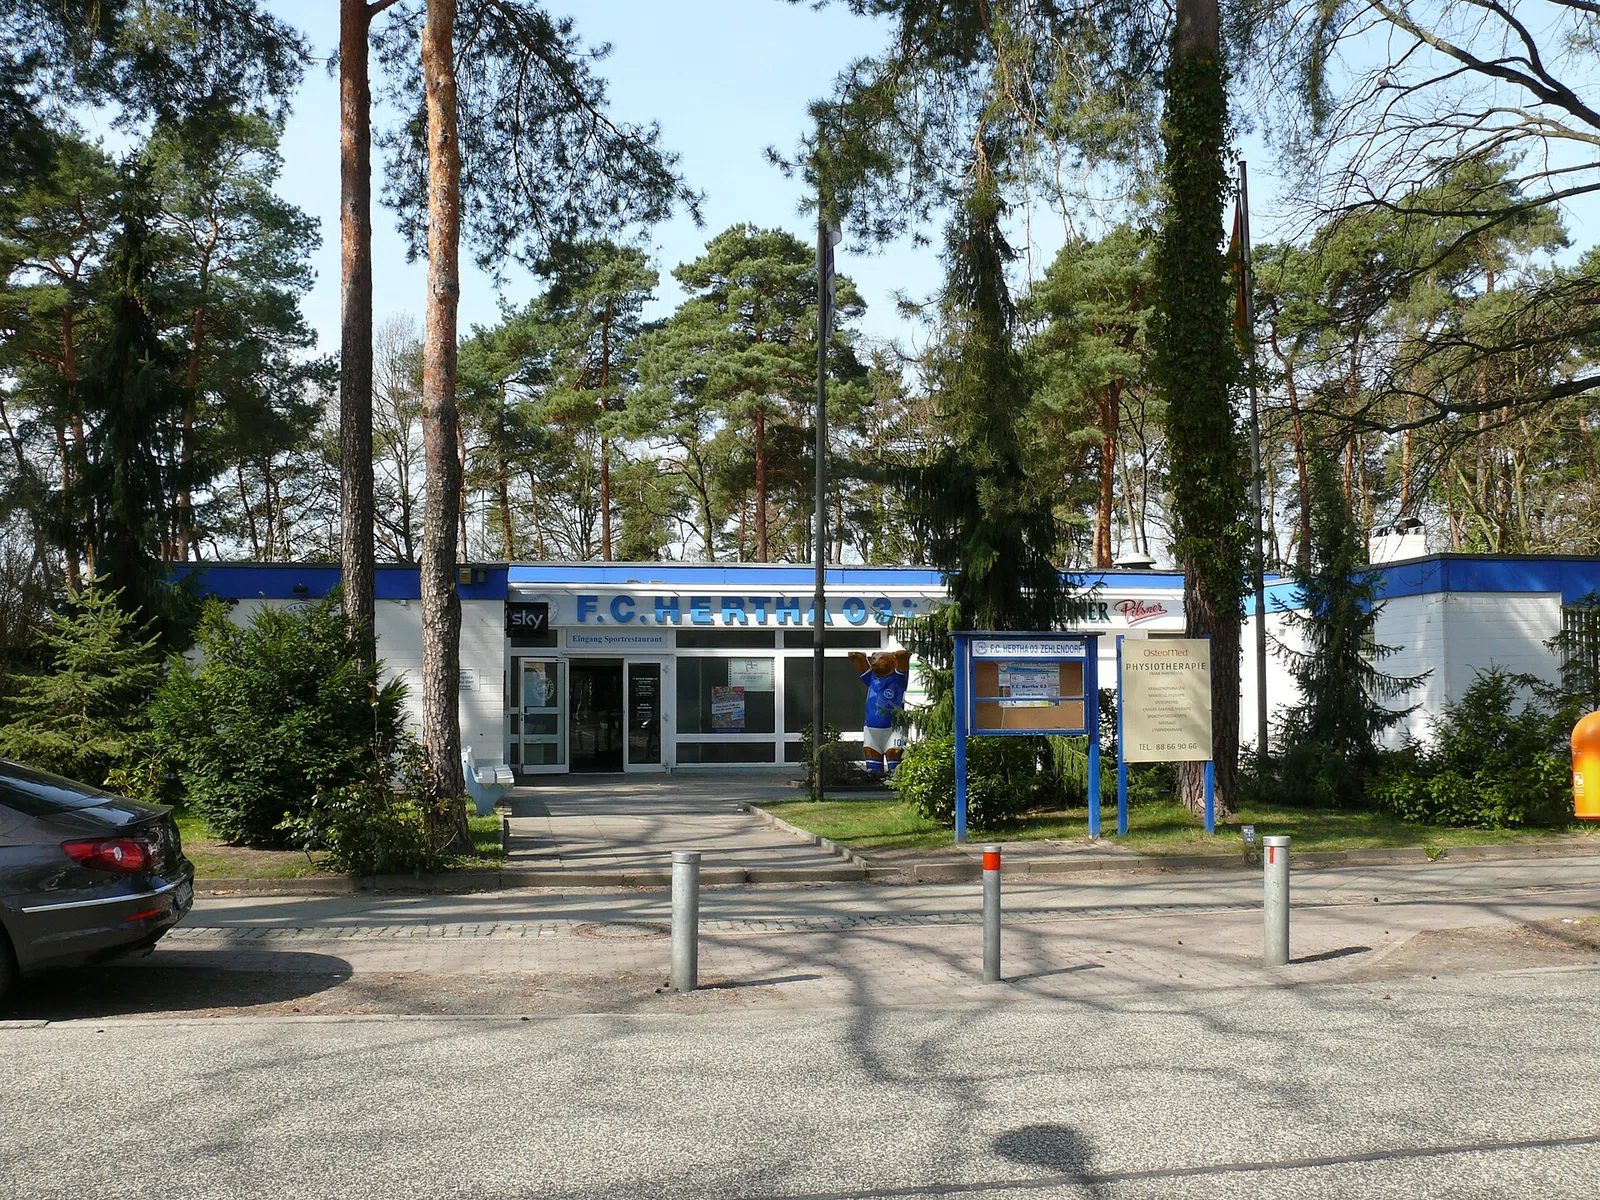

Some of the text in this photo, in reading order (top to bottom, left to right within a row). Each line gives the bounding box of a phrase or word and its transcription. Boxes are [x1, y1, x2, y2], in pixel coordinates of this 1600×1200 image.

[654, 596, 833, 624] HERTHA
[1114, 600, 1167, 624] Pilsner
[512, 610, 543, 629] sky
[572, 635, 662, 643] Eingang Sportrestaurant
[1003, 644, 1029, 654] HERTHA
[1030, 644, 1039, 654] 03
[1040, 644, 1084, 654] ZEHLENDORF
[1143, 649, 1188, 657] OsteoMed
[1126, 662, 1206, 670] PHYSIOTHERAPIE
[1139, 743, 1152, 751] TEL.
[1155, 743, 1165, 751] 88
[1166, 743, 1176, 751] 66
[1188, 742, 1198, 750] 66
